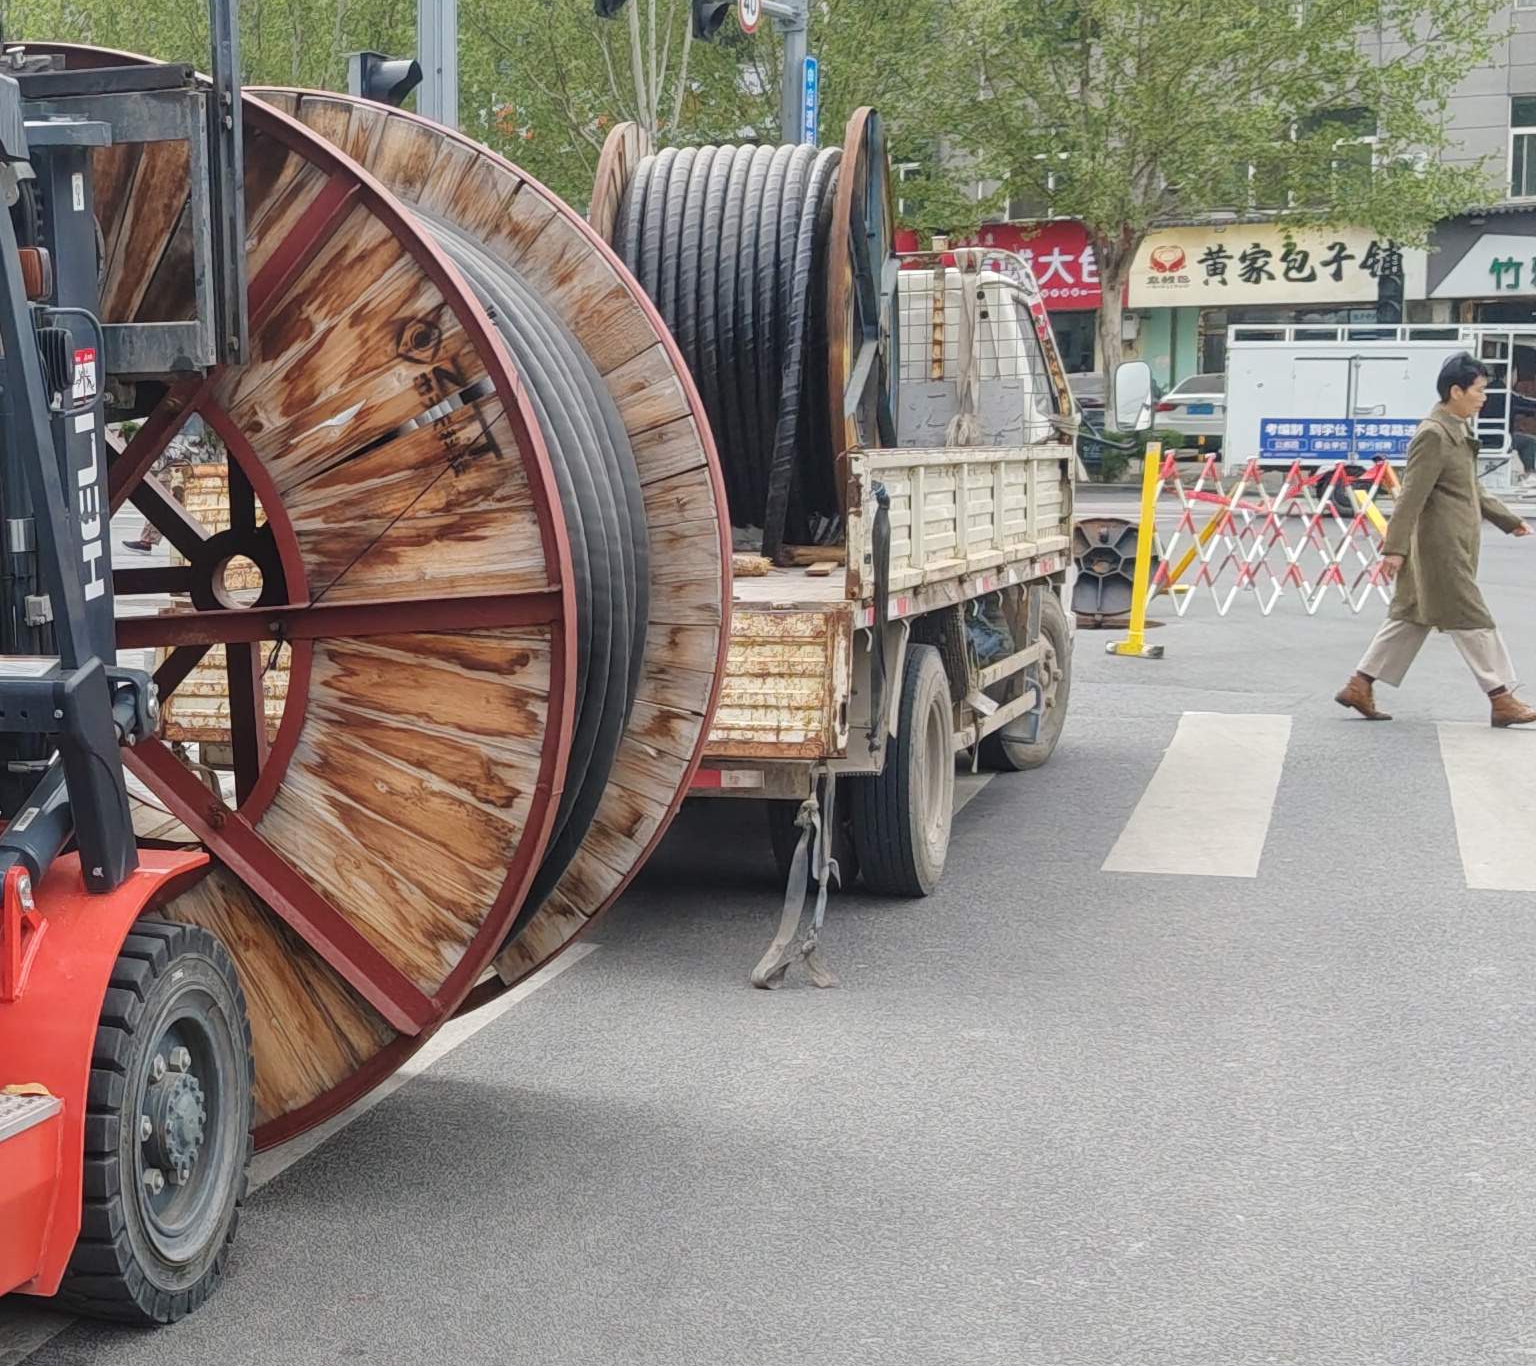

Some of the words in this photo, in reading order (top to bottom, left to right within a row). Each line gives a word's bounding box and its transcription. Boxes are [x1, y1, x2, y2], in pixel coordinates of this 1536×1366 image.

[1197, 239, 1403, 286] 黄家包子铺
[1489, 256, 1536, 290] 竹
[74, 411, 105, 602] HELI
